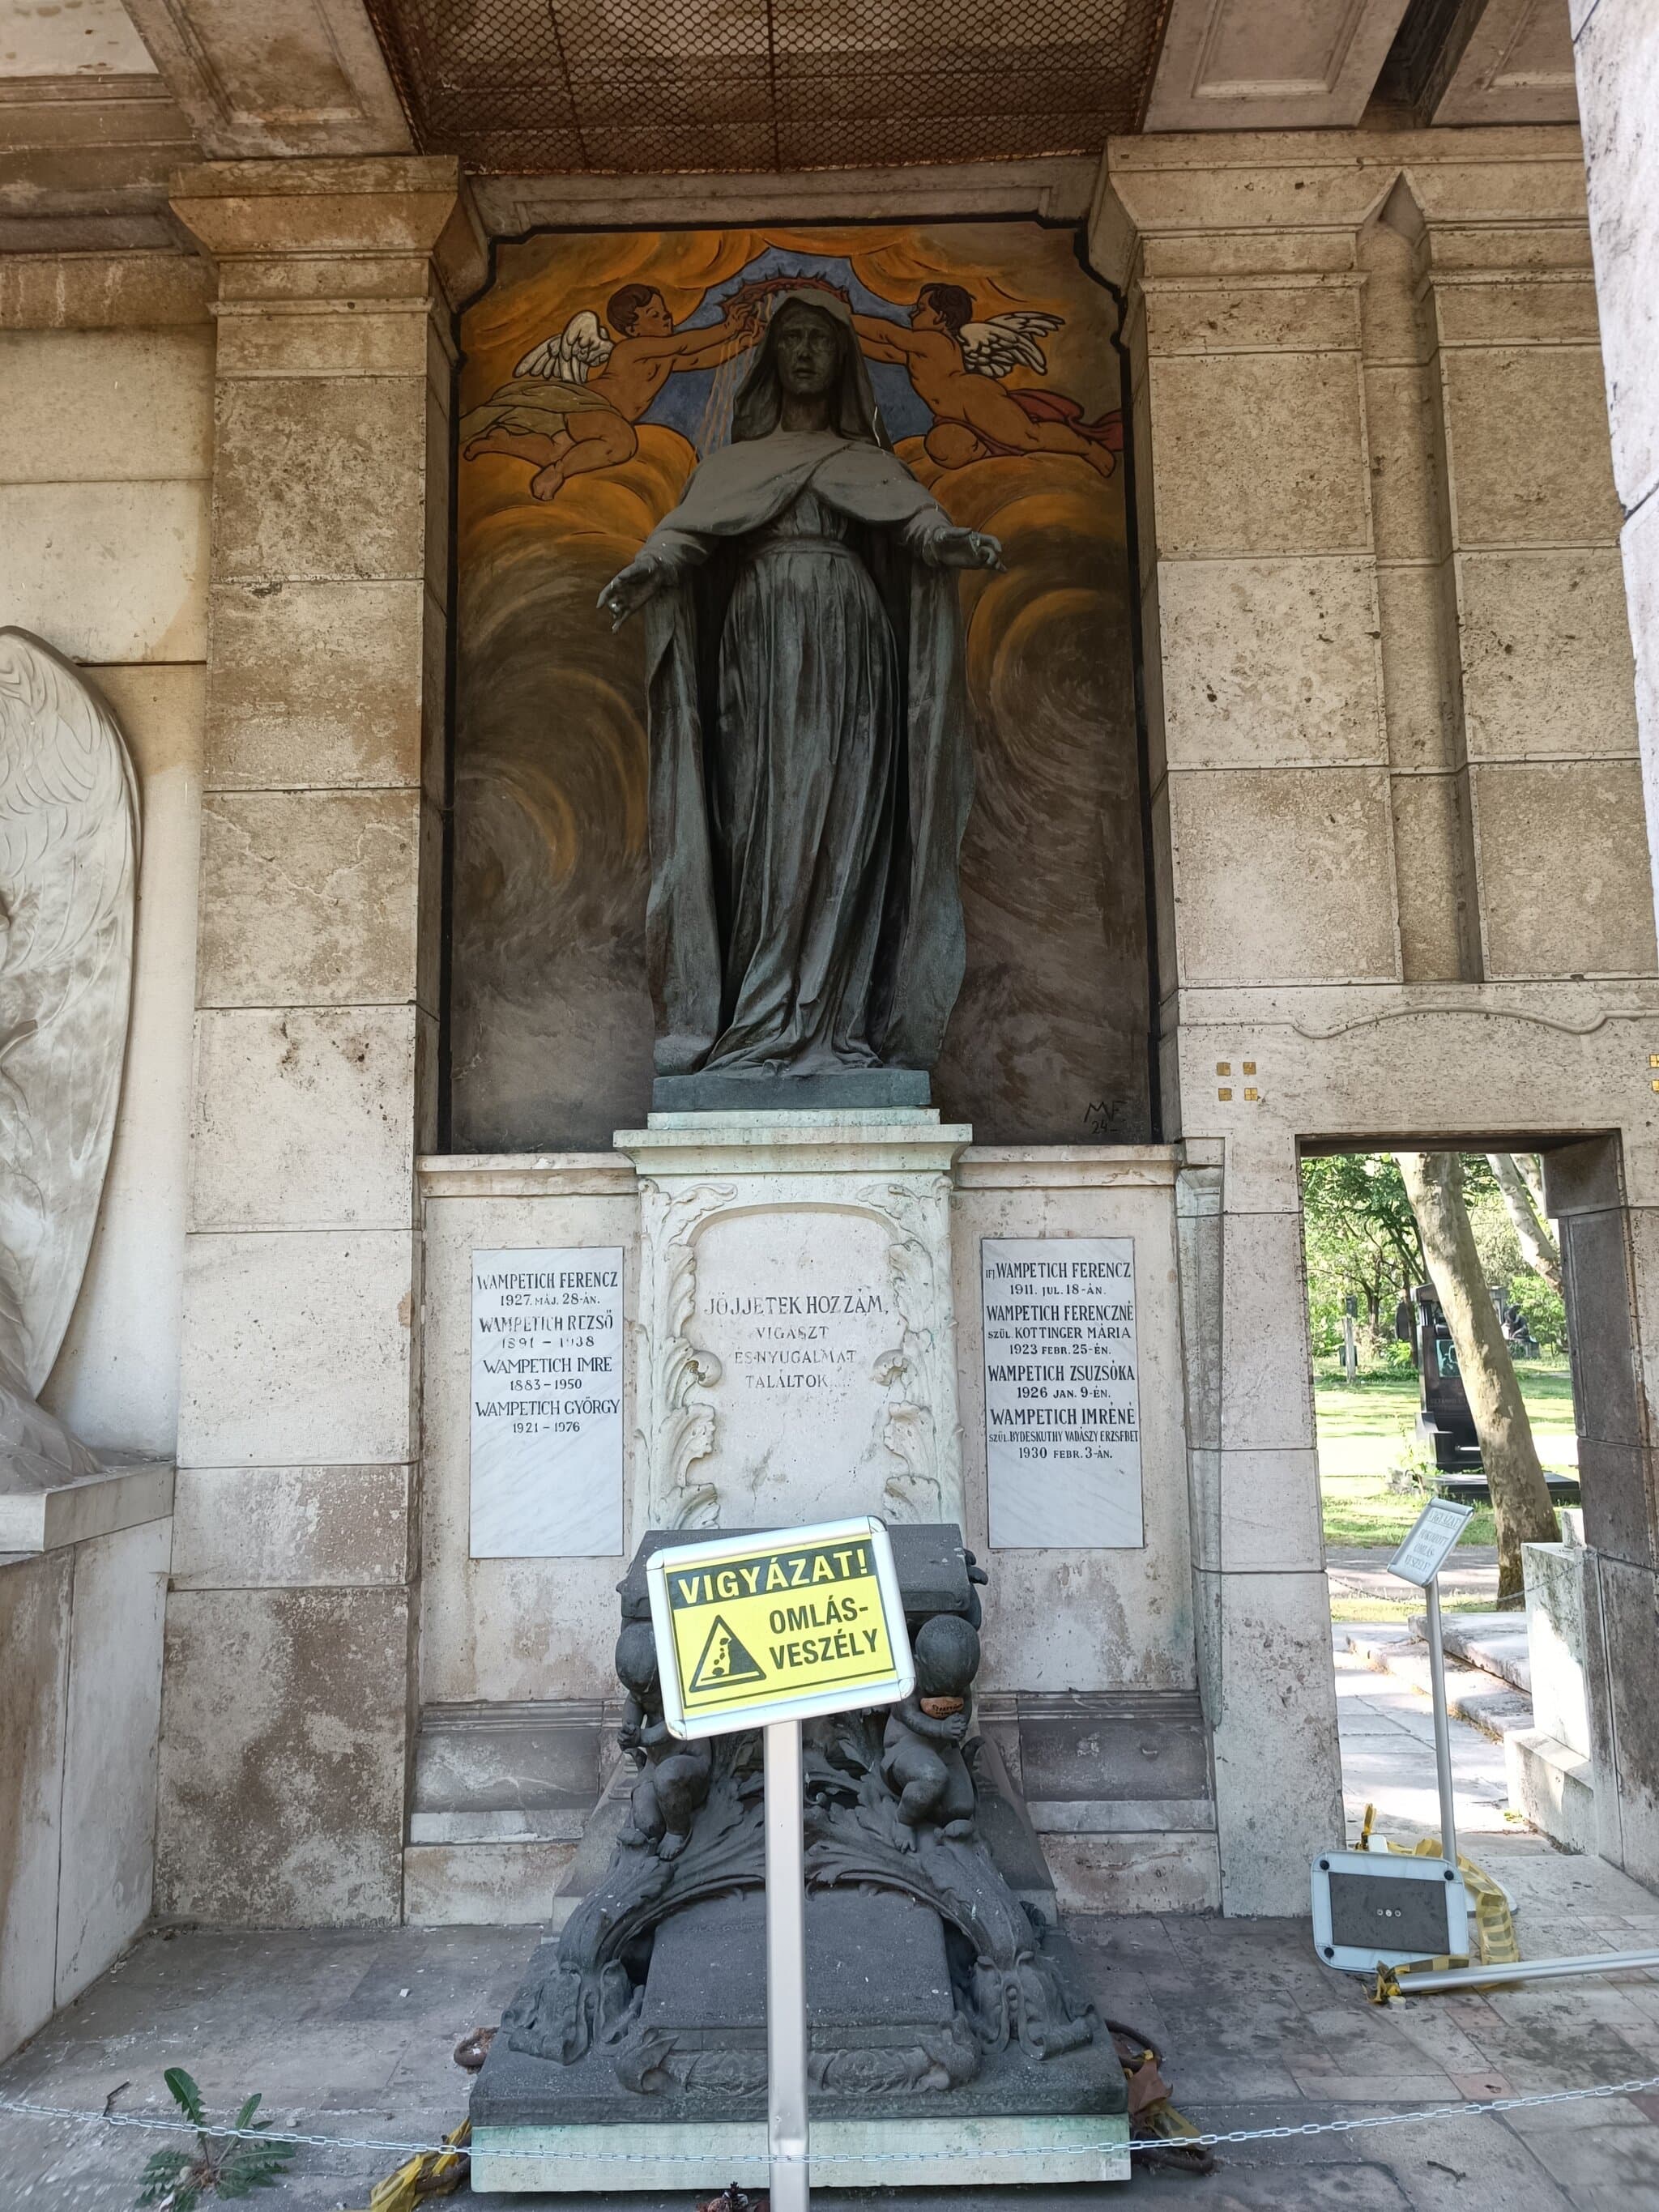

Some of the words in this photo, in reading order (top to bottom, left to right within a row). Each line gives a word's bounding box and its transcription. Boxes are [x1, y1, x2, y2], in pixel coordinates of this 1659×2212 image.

[996, 1263, 1067, 1279] WAMPETICH
[1072, 1262, 1131, 1278] FERENCZ
[477, 1272, 555, 1289] WAMPETICH
[559, 1272, 618, 1289] FERENCZ
[1010, 1284, 1037, 1295] 1911.
[501, 1294, 531, 1306] 1927.
[535, 1294, 559, 1306] MÁJ.
[562, 1292, 600, 1305] 28-ÁN.
[703, 1292, 802, 1315] JÖJJETEK
[987, 1305, 1060, 1321] WAMPETICH
[1064, 1301, 1134, 1321] FERENCZNÉ
[479, 1316, 563, 1332] WAMPETICH
[1015, 1326, 1082, 1339] KOTTINGER
[1087, 1323, 1132, 1339] MÁRIA
[755, 1326, 830, 1340] VIGASZT
[502, 1337, 535, 1349] 1891
[1010, 1344, 1038, 1355] 1923
[1042, 1345, 1071, 1355] FEBR.
[483, 1358, 571, 1374] WAMPETICH
[578, 1357, 612, 1372] IMRE
[987, 1365, 1064, 1382] WAMPETICH
[1070, 1360, 1135, 1381] ZSUZSÓKA
[510, 1379, 541, 1391] 1883
[555, 1379, 582, 1390] 1950
[1017, 1387, 1047, 1399] 1926
[1053, 1389, 1077, 1399] JAN.
[476, 1400, 560, 1417] WAMPETICH
[565, 1396, 621, 1415] GYÖRGY
[991, 1409, 1077, 1425] WAMPETICH
[1081, 1401, 1135, 1425] IMRÉNÉ
[513, 1422, 539, 1433] 1921
[554, 1421, 581, 1433] 1976
[1064, 1426, 1098, 1443] VADÁSZY
[1019, 1447, 1047, 1459] 1930
[1053, 1450, 1083, 1459] FEBR.
[678, 1549, 868, 1605] VIGYÁZAT!
[770, 1595, 869, 1634] OMLÁS-
[770, 1628, 878, 1669] VESZÉLY
